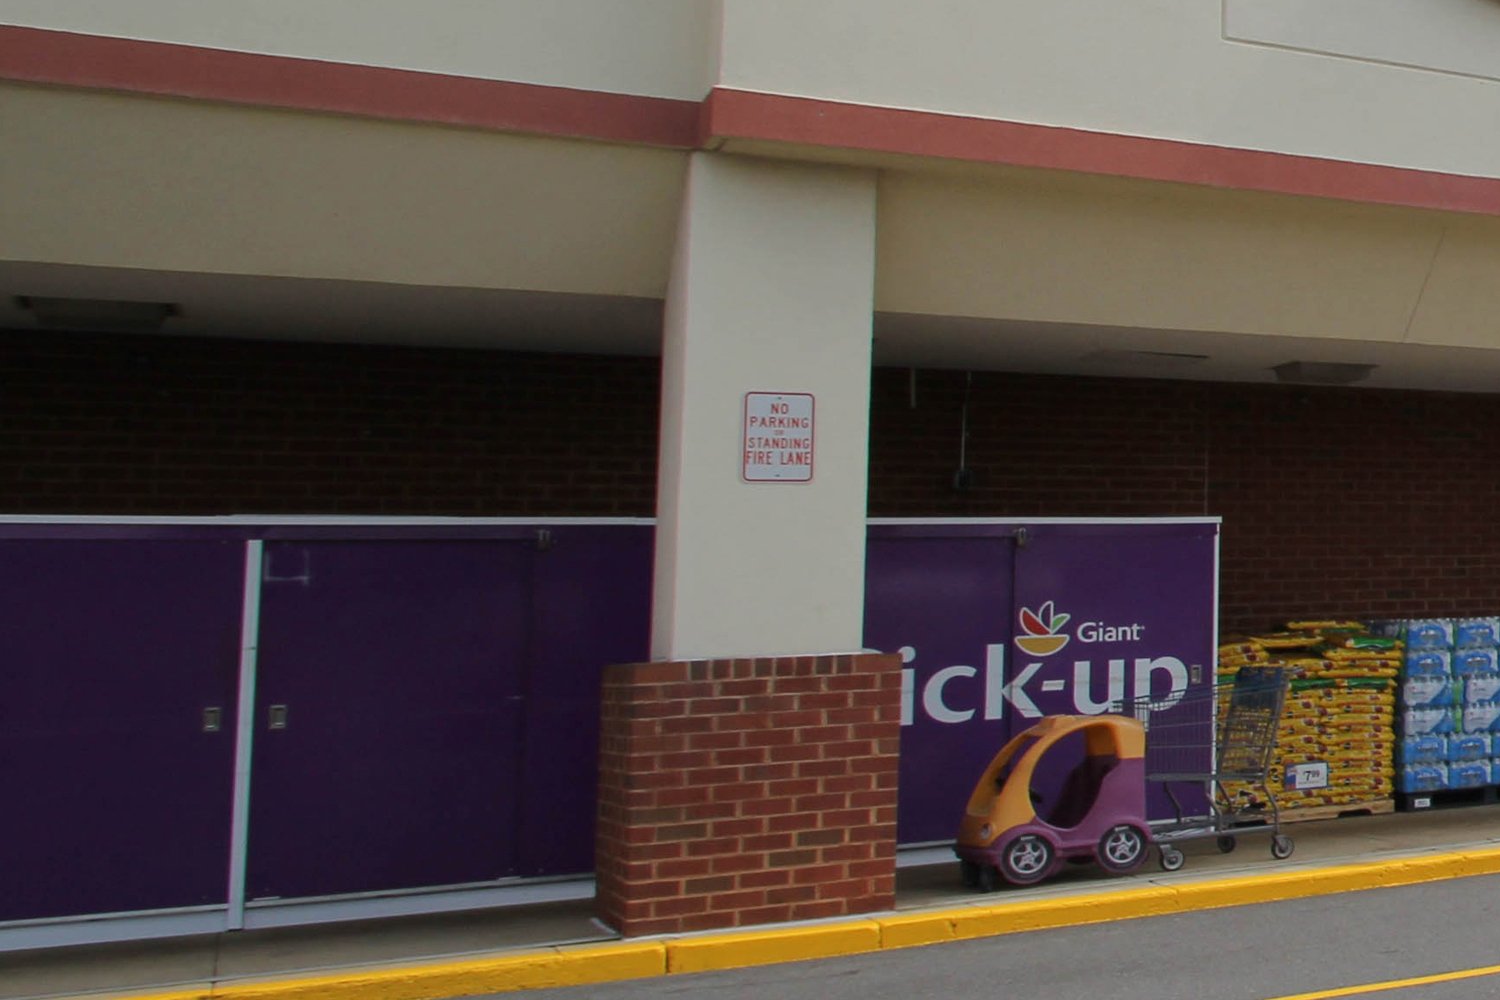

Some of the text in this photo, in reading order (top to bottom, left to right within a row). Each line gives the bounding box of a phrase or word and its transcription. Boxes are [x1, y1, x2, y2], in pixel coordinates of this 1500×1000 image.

[770, 402, 790, 415] NO
[749, 416, 810, 429] PARKING
[747, 437, 810, 450] STANDING
[744, 450, 811, 466] FIRE LANE
[1076, 621, 1141, 643] Giant
[897, 643, 1190, 733] ick-up
